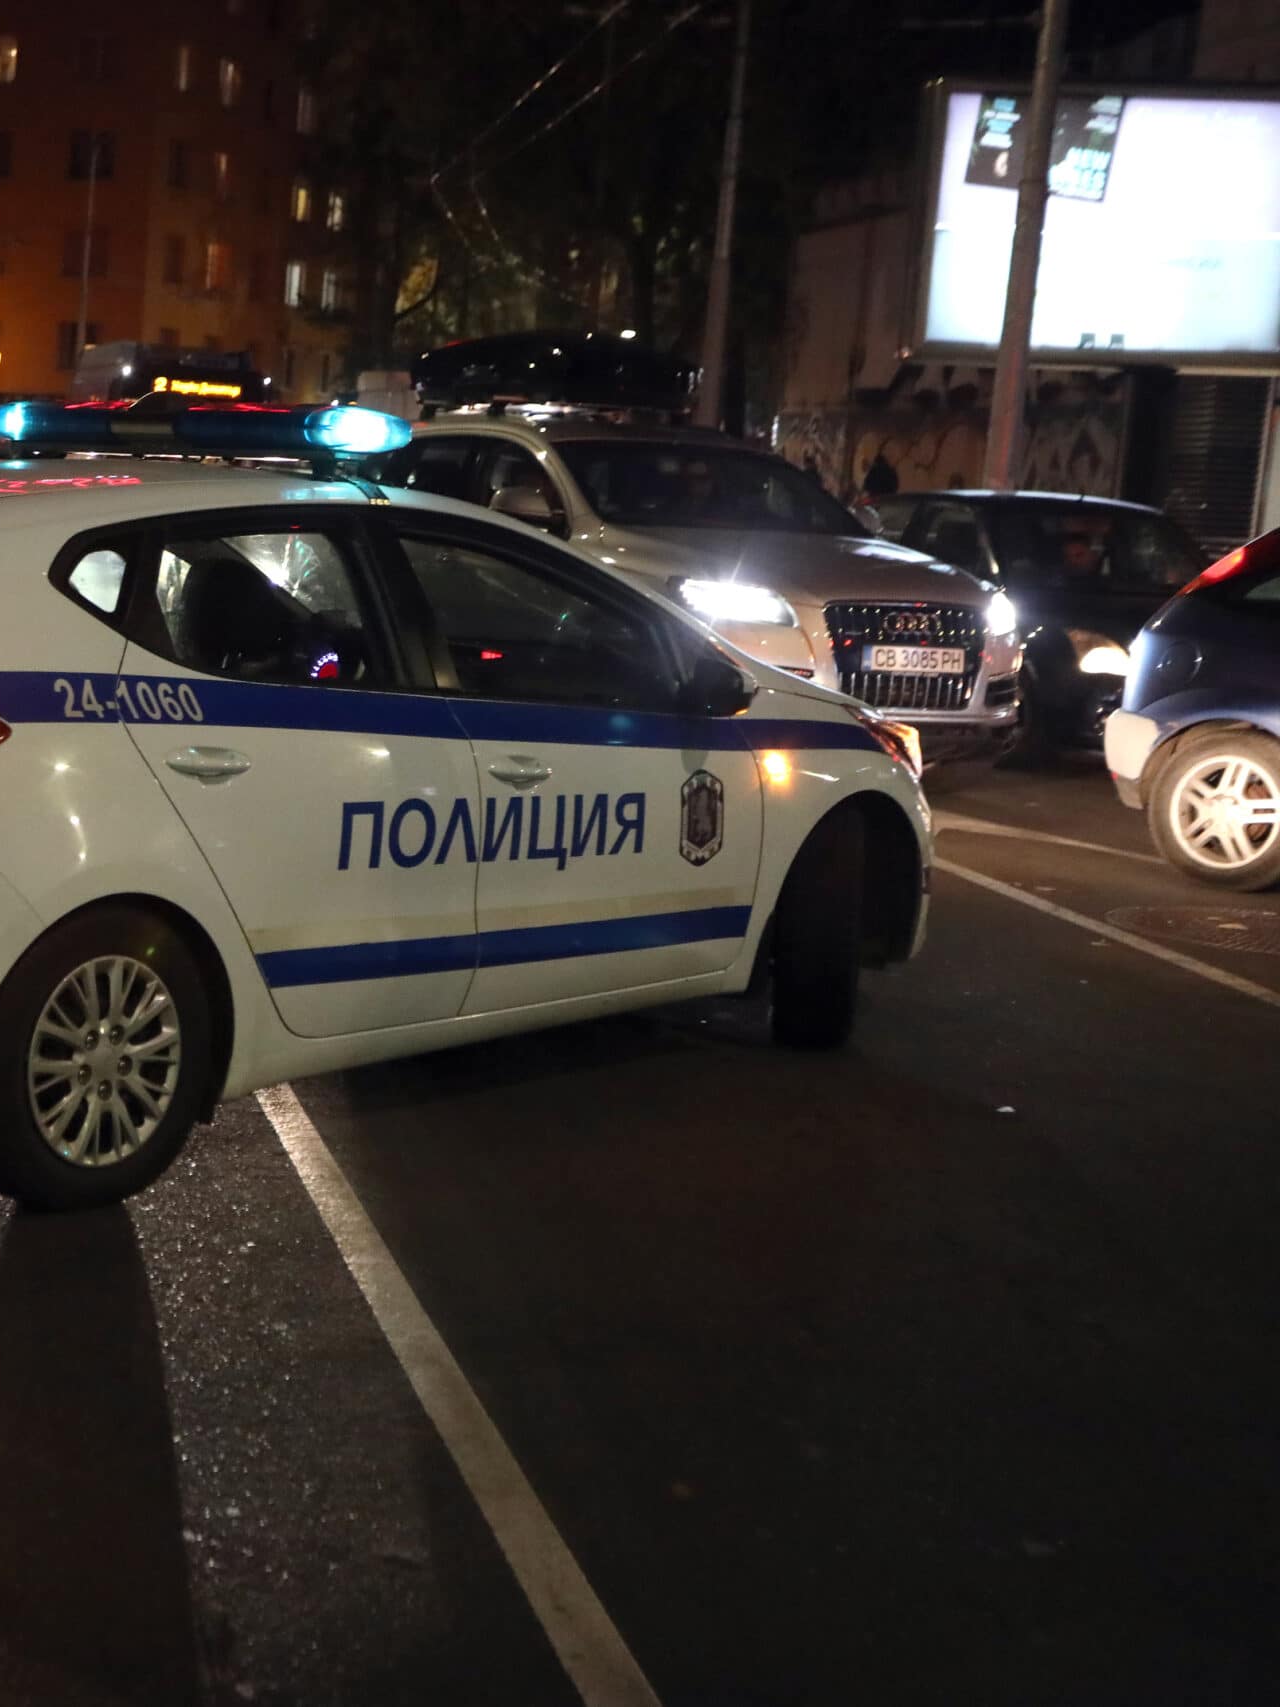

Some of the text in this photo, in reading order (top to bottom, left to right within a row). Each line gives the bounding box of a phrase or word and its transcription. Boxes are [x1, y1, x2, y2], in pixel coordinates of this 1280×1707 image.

[154, 376, 168, 392] 2
[53, 678, 204, 722] 24-1060
[337, 792, 646, 871] ПОЛИЦИЯ
